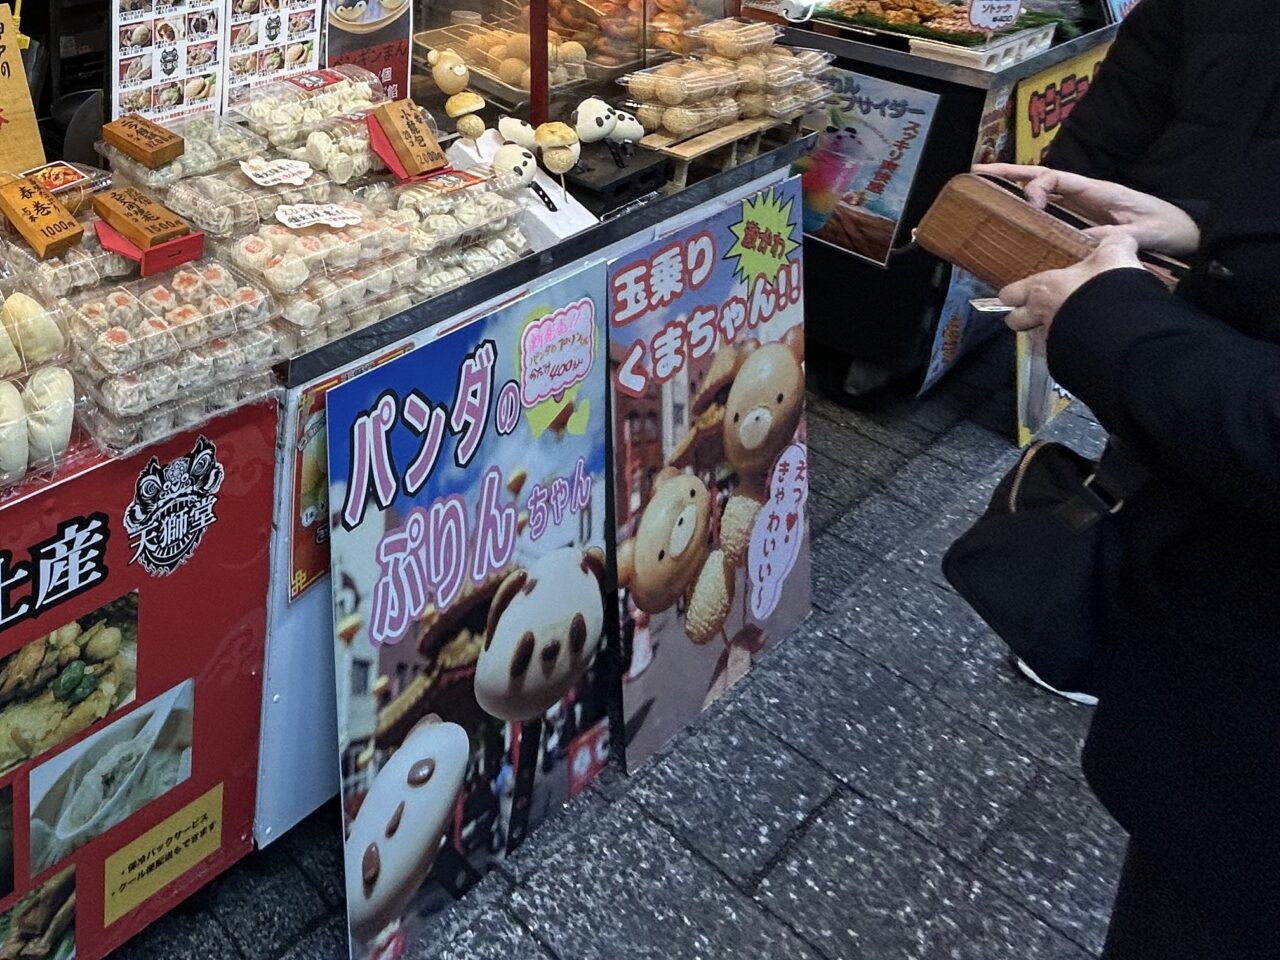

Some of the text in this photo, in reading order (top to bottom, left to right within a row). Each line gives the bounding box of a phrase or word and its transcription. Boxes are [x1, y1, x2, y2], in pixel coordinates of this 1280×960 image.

[982, 4, 1011, 13] ソトック
[19, 186, 51, 217] 春巻
[40, 219, 76, 238] 1000円
[145, 220, 183, 234] 1500円
[611, 231, 718, 326] 玉乗り
[617, 257, 801, 397] くまちゃん!!
[342, 339, 523, 534] パンダの
[127, 496, 218, 566] 天獅堂
